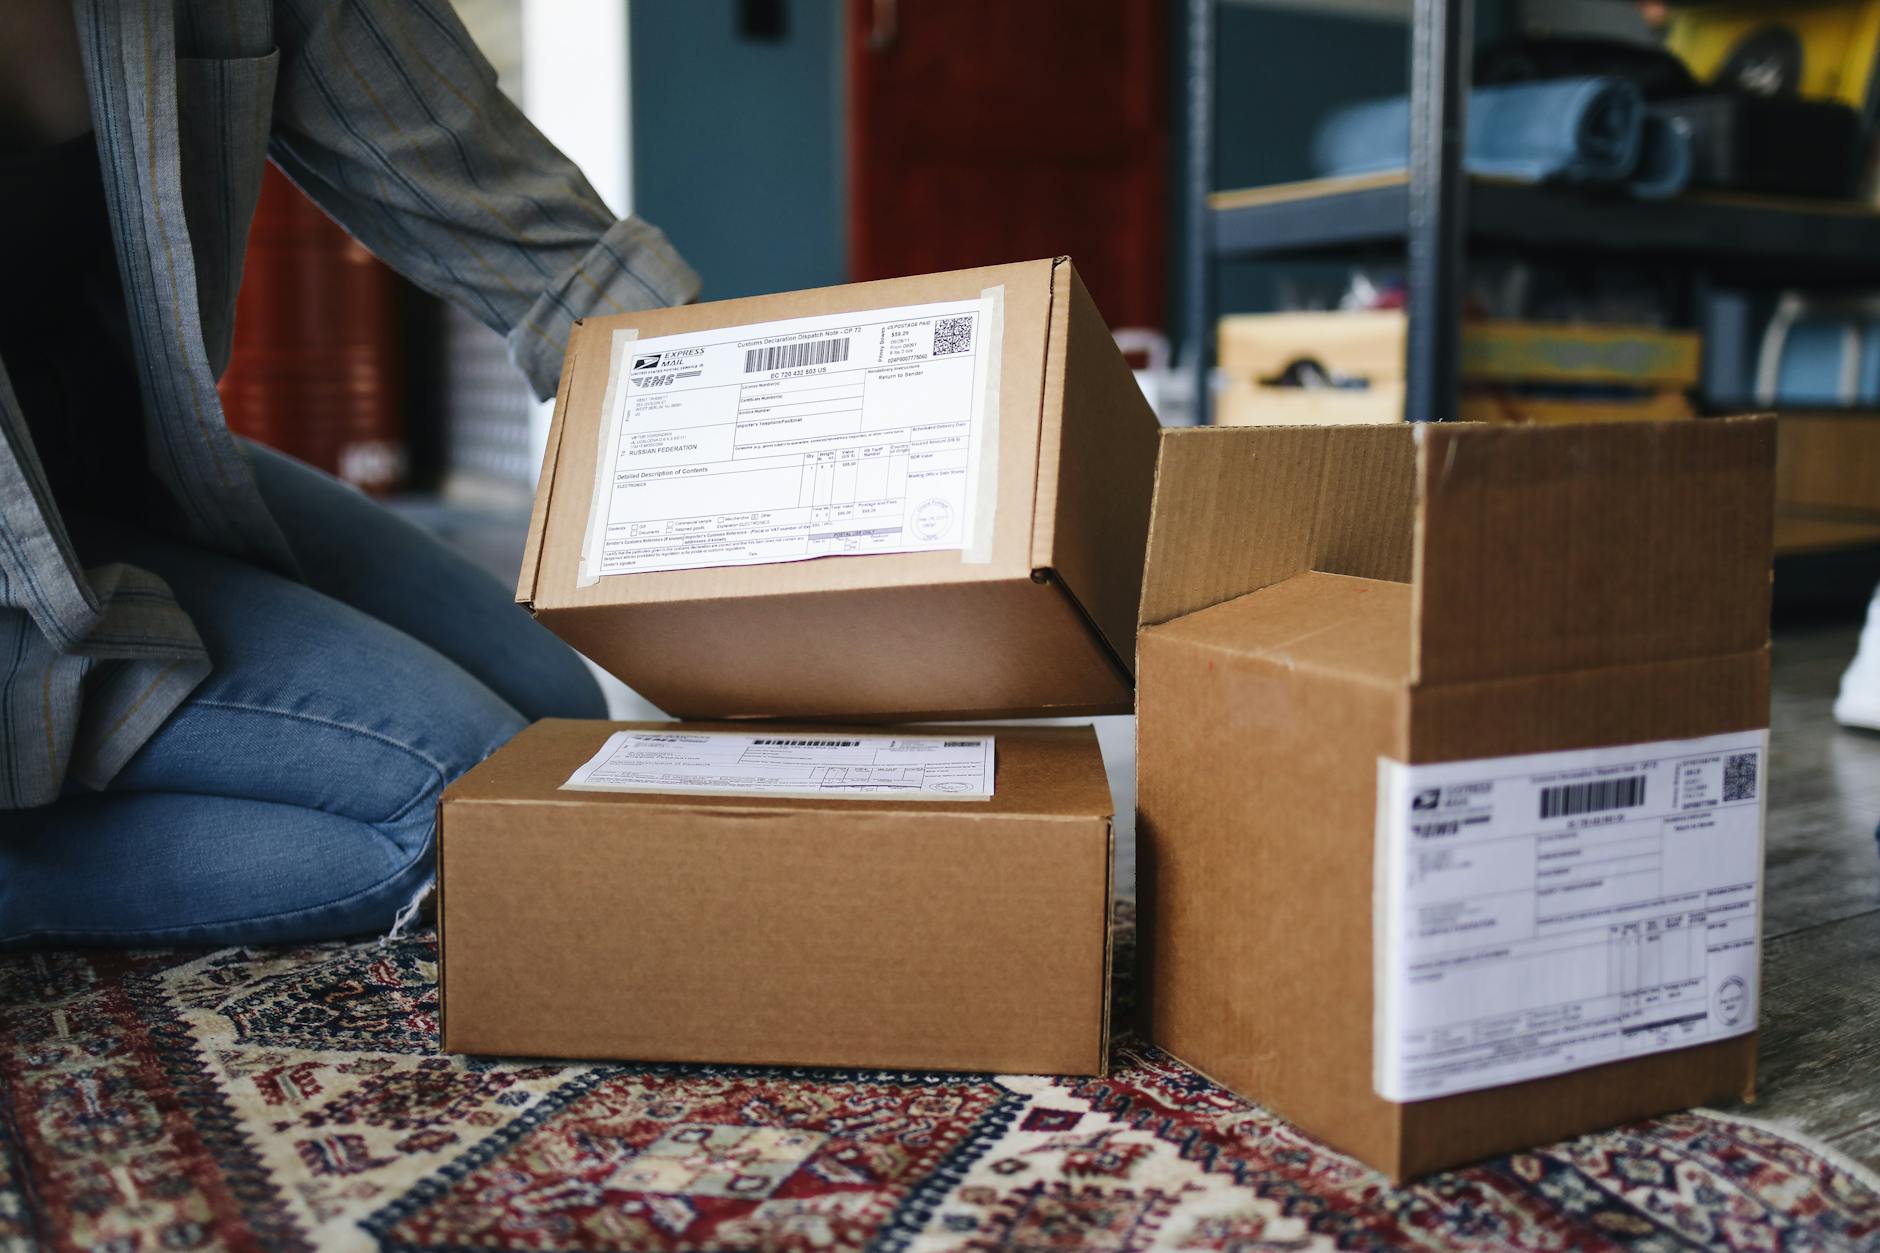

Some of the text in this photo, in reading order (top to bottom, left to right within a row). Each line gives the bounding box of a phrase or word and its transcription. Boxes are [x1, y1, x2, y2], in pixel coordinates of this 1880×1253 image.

[764, 336, 796, 344] Declaration
[798, 333, 823, 341] Dispatch
[664, 348, 705, 358] EXPRESS
[642, 374, 675, 388] EMS
[658, 444, 697, 453] FEDERATION
[641, 470, 673, 478] Description
